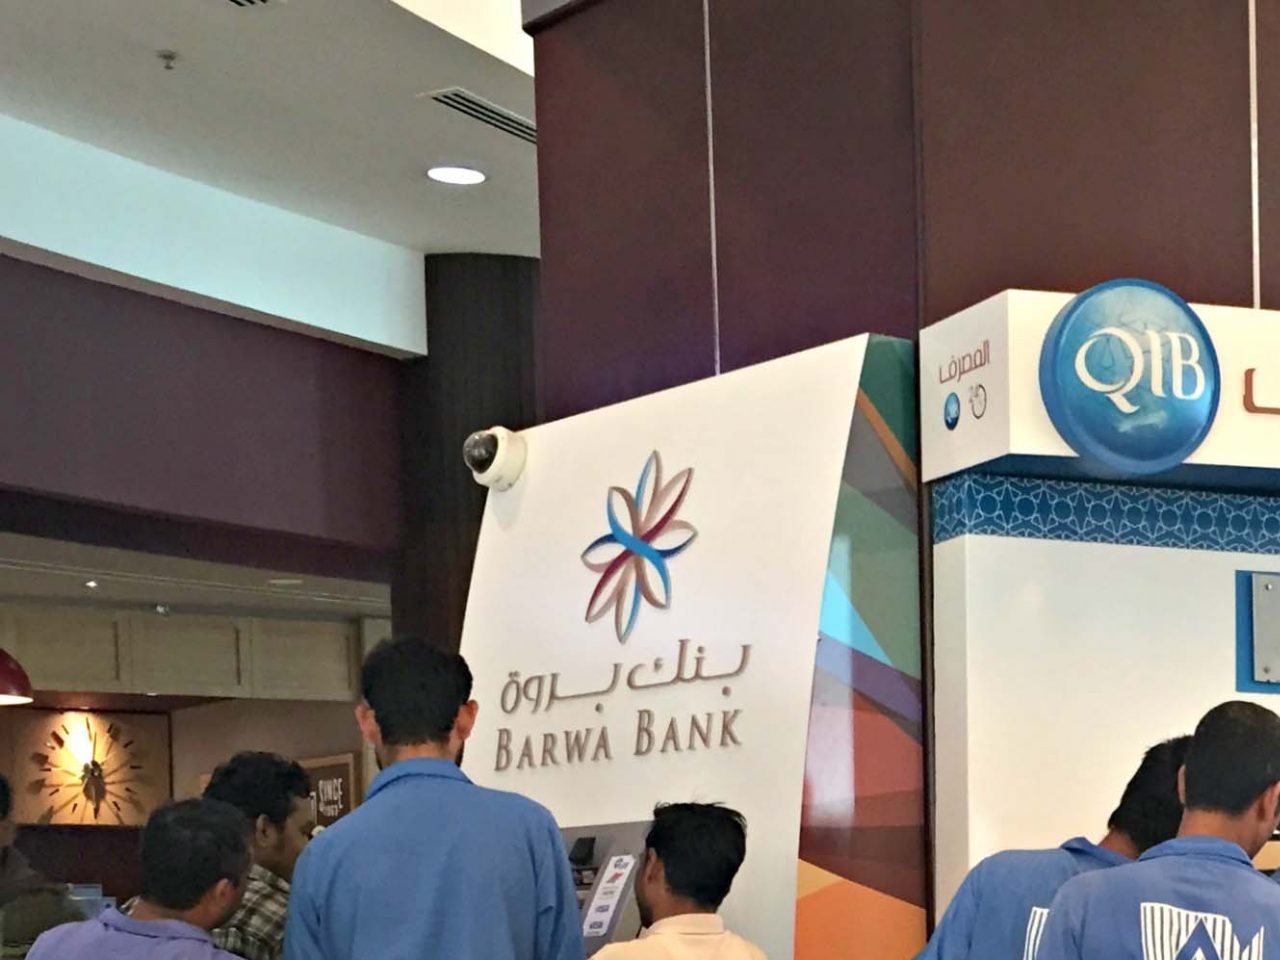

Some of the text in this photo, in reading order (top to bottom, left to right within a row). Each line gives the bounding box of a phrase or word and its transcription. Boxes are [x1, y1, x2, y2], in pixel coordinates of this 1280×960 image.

[1074, 326, 1206, 415] QIB
[500, 639, 752, 715] بنك بروة
[494, 709, 743, 772] BARWA BANK
